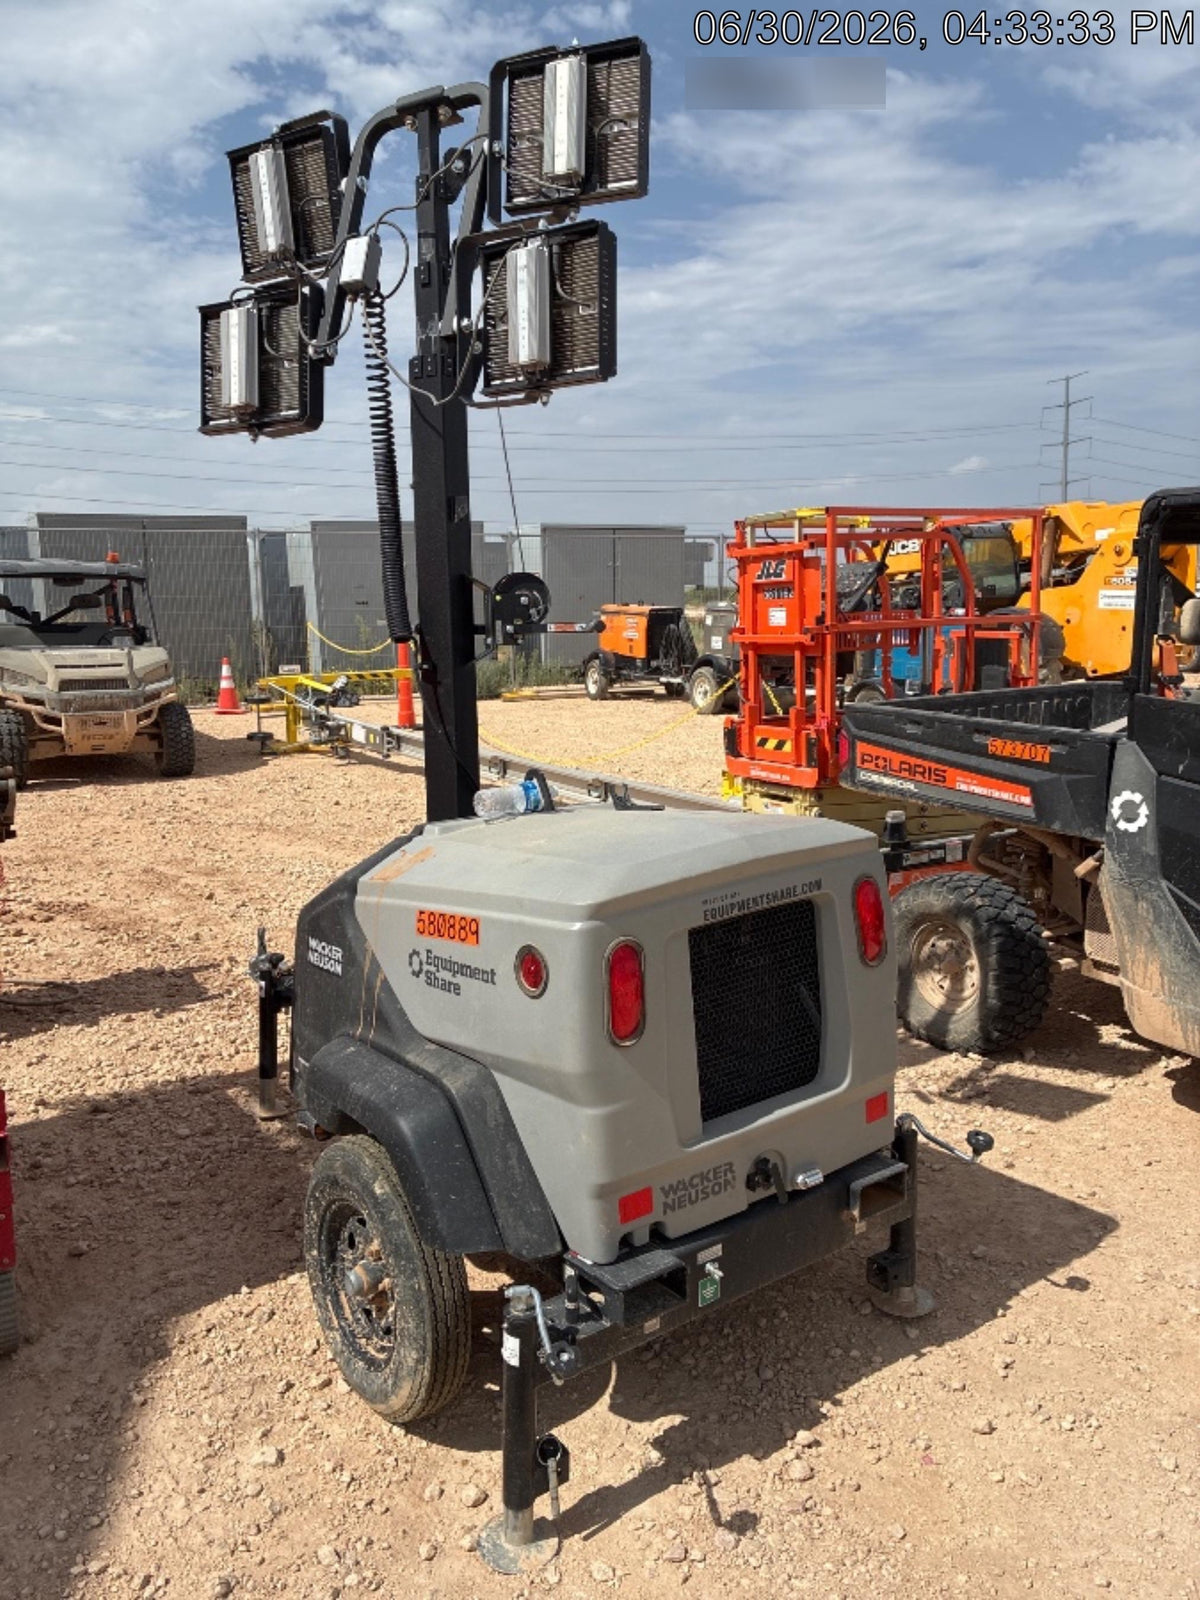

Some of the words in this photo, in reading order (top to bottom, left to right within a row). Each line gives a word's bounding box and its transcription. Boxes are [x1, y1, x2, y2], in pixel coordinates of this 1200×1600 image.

[889, 538, 920, 556] JCB
[755, 559, 787, 581] JLG
[860, 753, 948, 784] POLARIS
[703, 878, 823, 922] EQUIPMENTSHARE.COM
[416, 910, 480, 944] 580889
[308, 936, 343, 961] WACKER
[308, 950, 342, 977] NEUSON
[424, 969, 462, 997] Share
[425, 949, 497, 986] Equipment
[660, 1161, 737, 1199] WACKER
[662, 1175, 737, 1216] NEUSON
